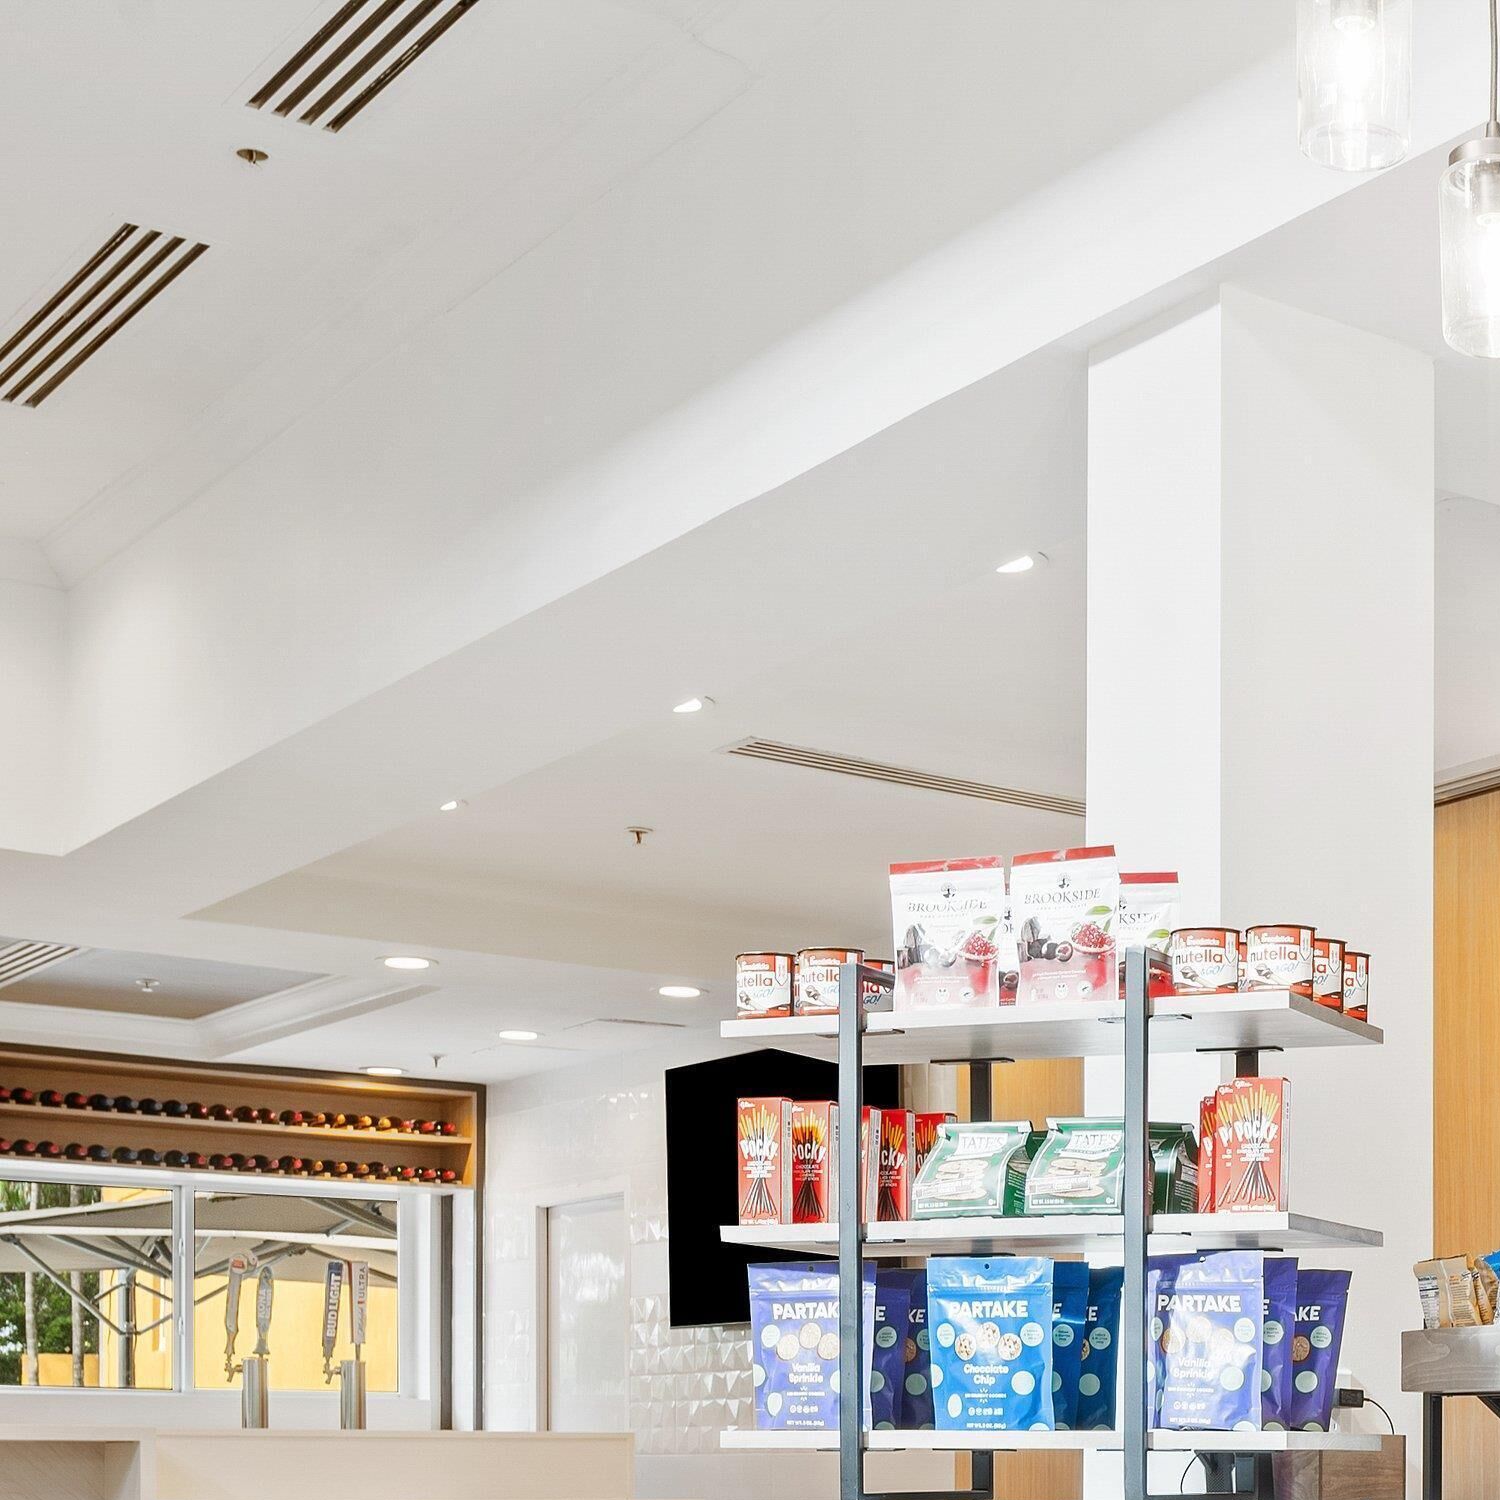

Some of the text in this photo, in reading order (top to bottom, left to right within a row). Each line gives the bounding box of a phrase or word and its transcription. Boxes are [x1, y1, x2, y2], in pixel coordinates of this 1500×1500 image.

[1024, 887, 1102, 906] BROOKSIDE
[907, 898, 988, 913] BROOKSIDE
[1175, 949, 1223, 965] nutella
[1250, 946, 1298, 962] nutella
[961, 1135, 1005, 1149] TATE'S
[1074, 1133, 1120, 1147] TATE'S
[359, 1267, 367, 1298] ULTRA
[326, 1272, 342, 1338] BUD LIGHT
[772, 1302, 840, 1320] PARTAK
[949, 1300, 1029, 1319] PARTAKE
[1157, 1295, 1242, 1313] PARTAKE
[791, 1362, 821, 1373] Vanilla
[963, 1363, 1010, 1375] Chocolate
[788, 1373, 824, 1385] Sprinkle
[973, 1374, 997, 1386] Chip
